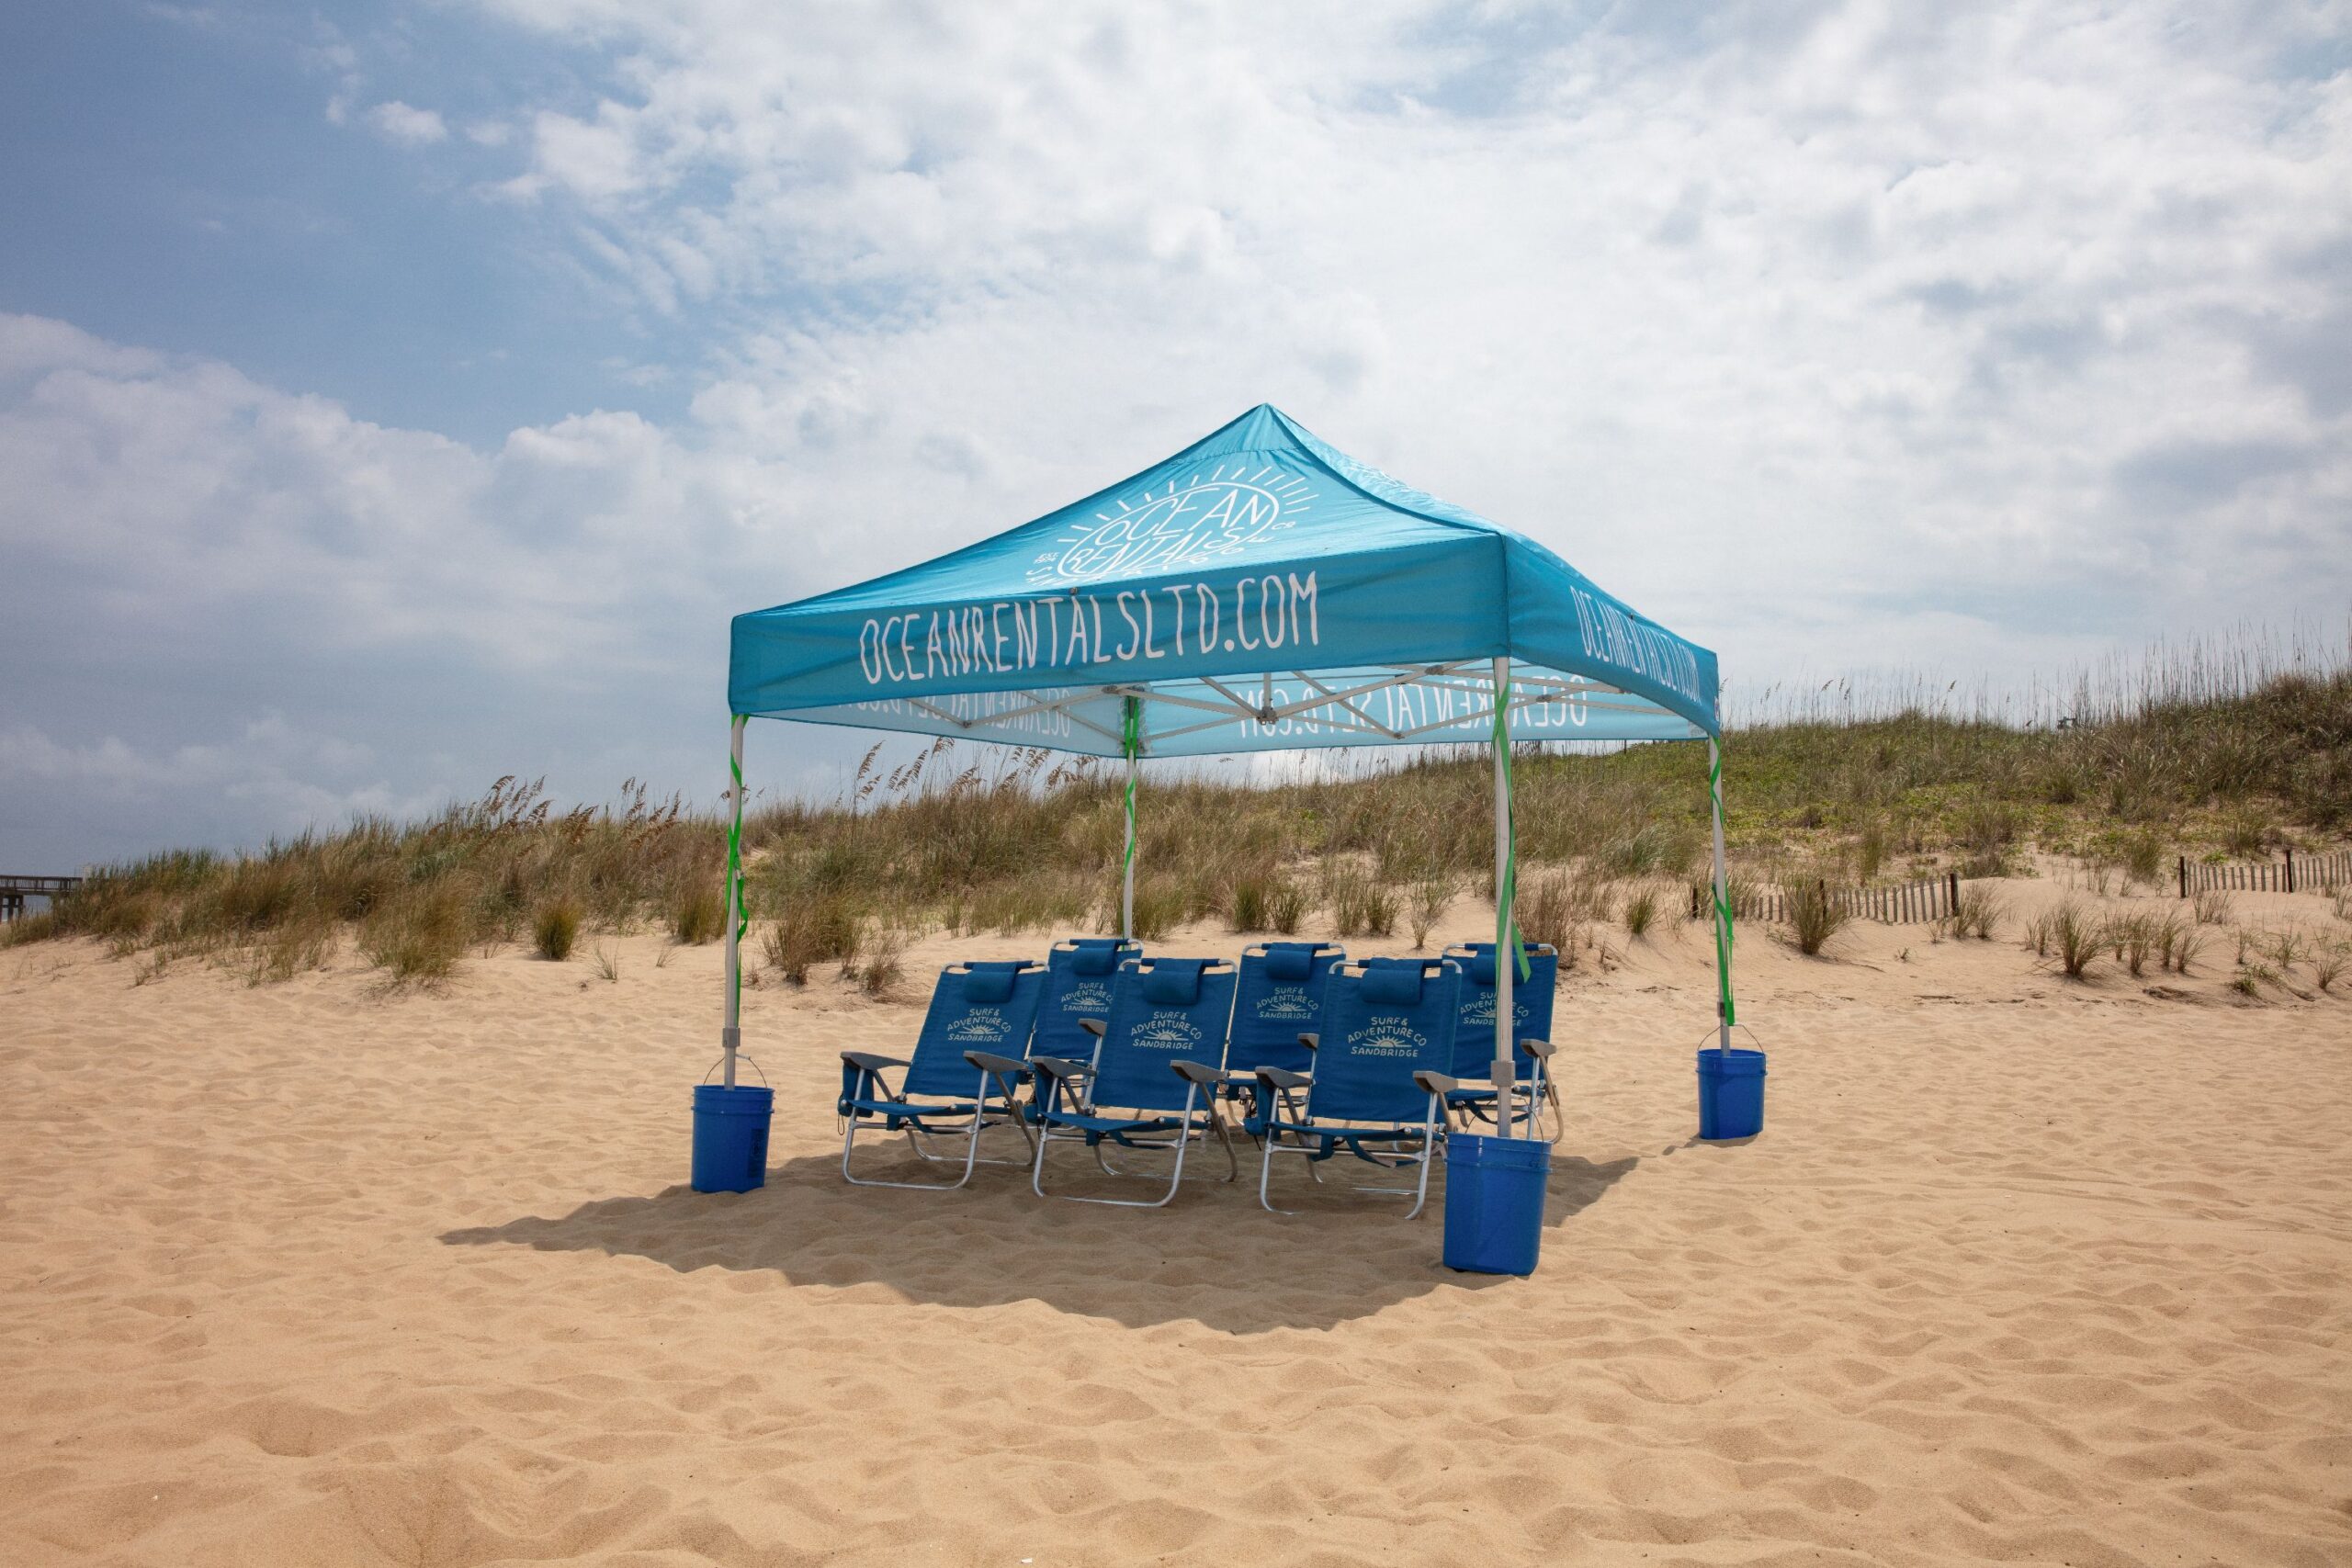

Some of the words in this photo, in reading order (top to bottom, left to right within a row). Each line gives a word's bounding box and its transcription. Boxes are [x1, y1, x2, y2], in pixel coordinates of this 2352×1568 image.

[1095, 488, 1271, 546] OCEAN
[1067, 527, 1245, 575] RENTALS
[859, 570, 1318, 685] OCEANRENTALSLTD.COM
[1079, 982, 1100, 990] SURF
[1274, 987, 1297, 995] SURF
[1061, 988, 1106, 1003] ADVENTURE
[1256, 994, 1307, 1010] ADVENTURE
[1307, 999, 1319, 1010] CO
[969, 1008, 993, 1017] SURF
[1063, 1004, 1110, 1013] SANDBRIDGE
[1517, 1006, 1529, 1017] CO
[1153, 1011, 1180, 1020] SURF
[1180, 1012, 1187, 1021] &
[1259, 1010, 1312, 1020] SANDBRIDGE
[947, 1016, 1002, 1032] ADVENTURE
[1001, 1021, 1012, 1032] CO
[1371, 1016, 1401, 1026] SURF
[1401, 1018, 1408, 1026] &
[1131, 1020, 1191, 1036] ADVENTURE
[1190, 1027, 1203, 1040] CO
[1348, 1025, 1414, 1043] ADVENTURE
[1413, 1033, 1427, 1046] CO
[948, 1033, 1003, 1043] SANDBRIDGE
[1132, 1038, 1194, 1050] SANDBRIDGE
[1351, 1046, 1419, 1057] SANDBRIDGE
